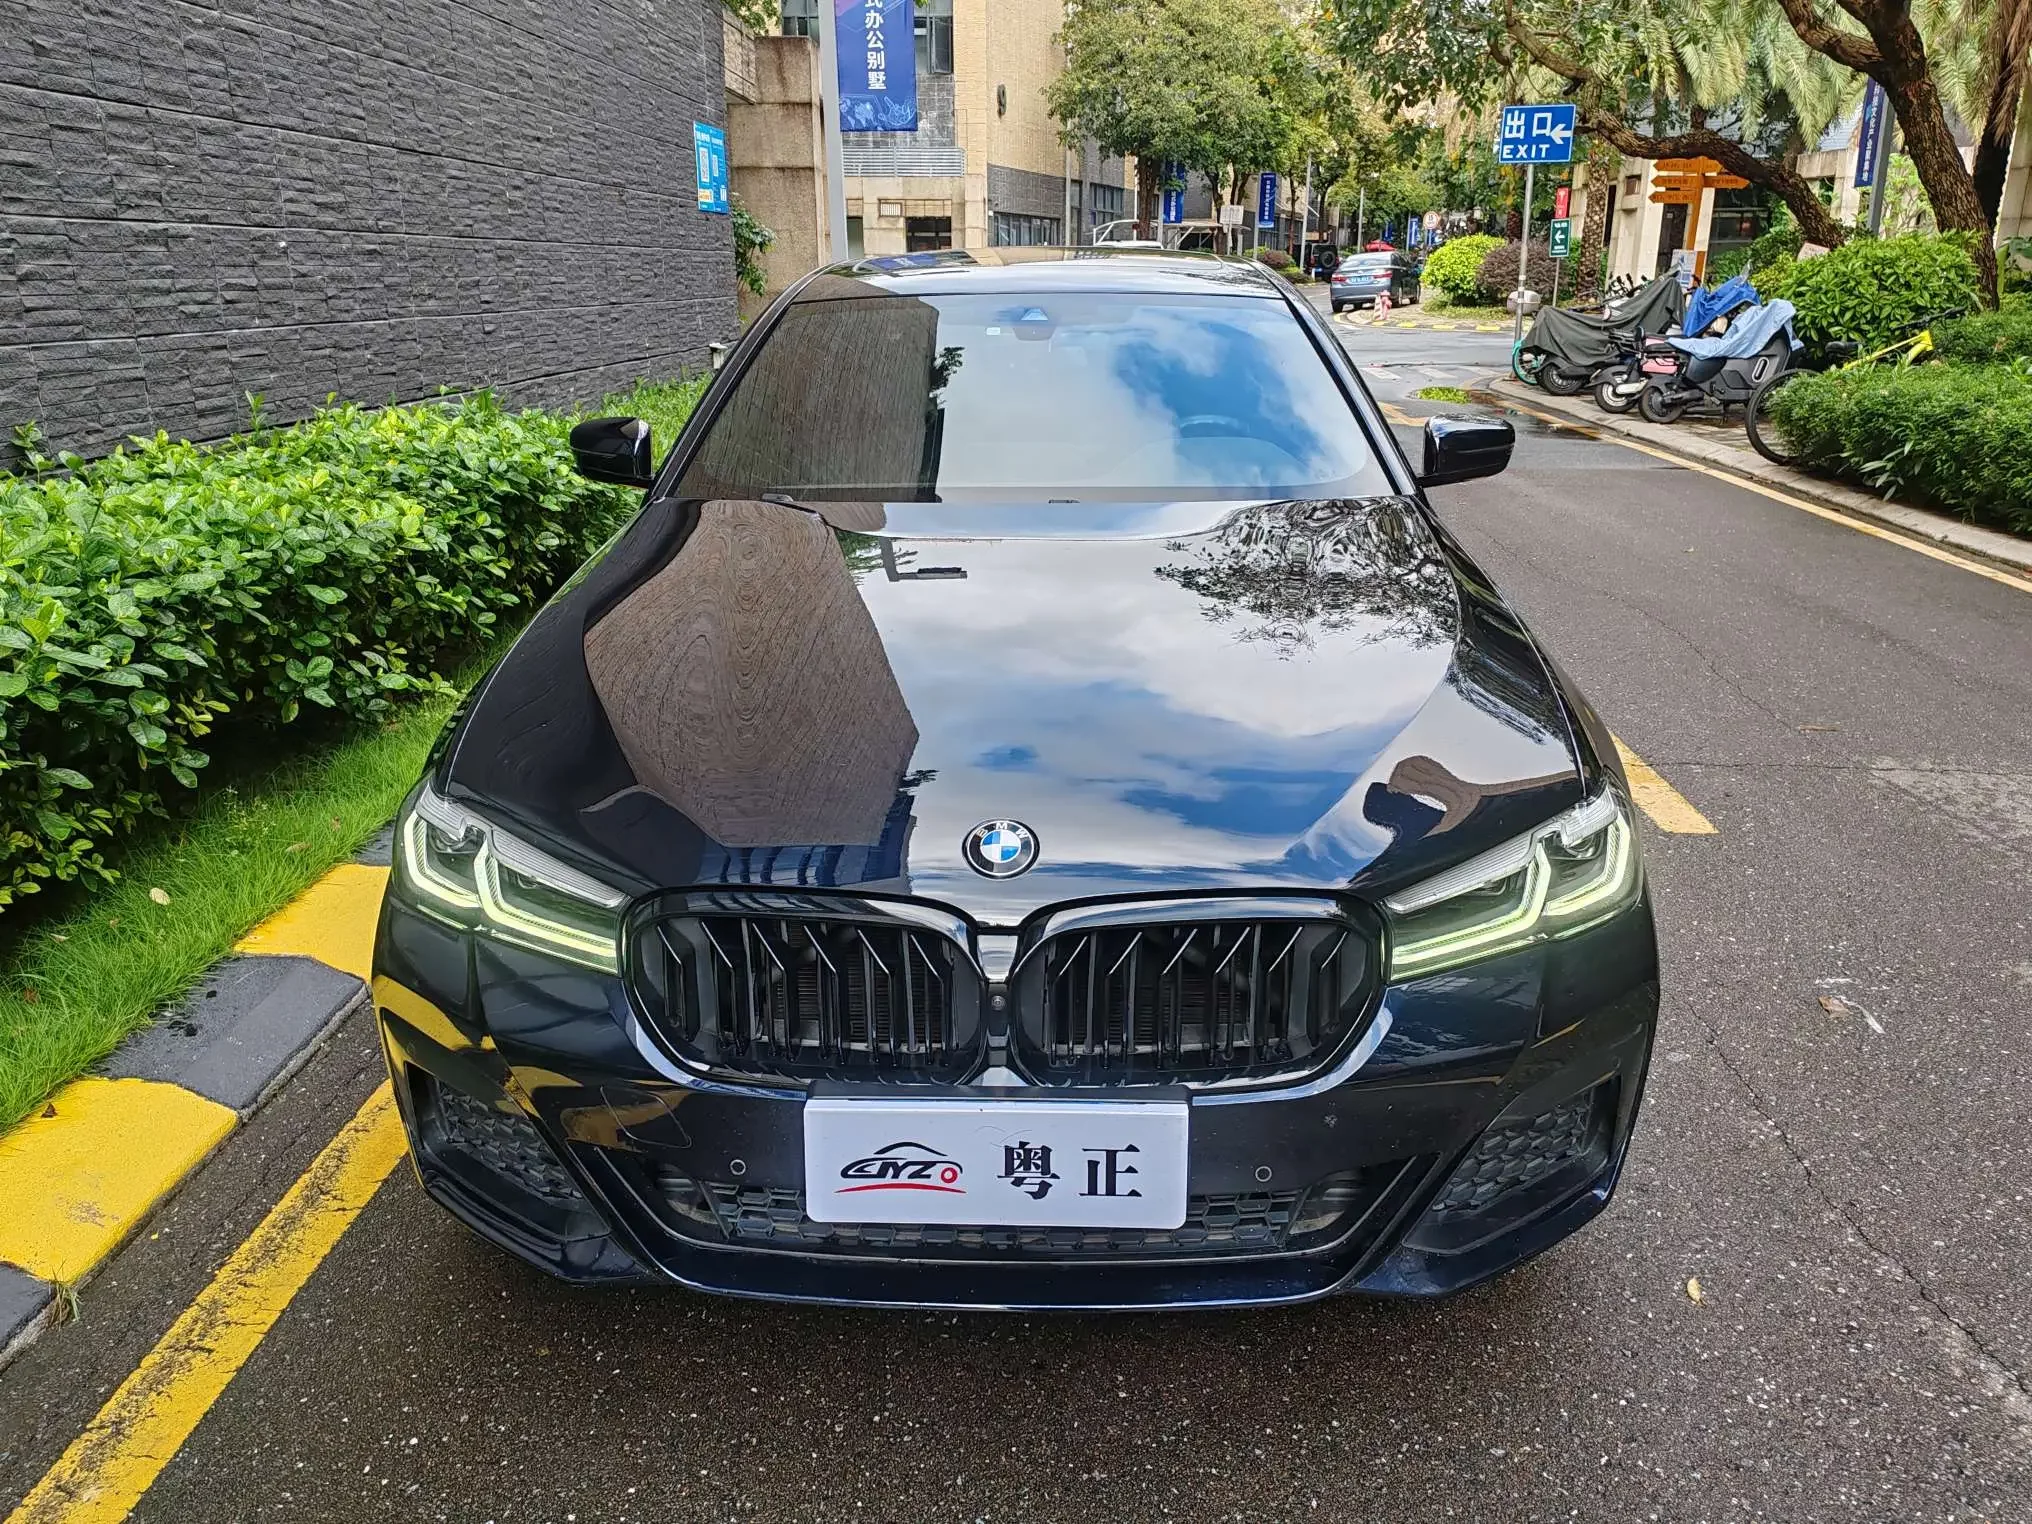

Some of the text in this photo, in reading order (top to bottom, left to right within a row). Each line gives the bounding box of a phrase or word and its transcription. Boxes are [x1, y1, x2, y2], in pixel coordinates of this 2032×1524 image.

[1504, 110, 1552, 139] 出口
[1502, 144, 1550, 158] EXIT
[976, 822, 1029, 839] BMW
[997, 1141, 1142, 1200] 粤正
